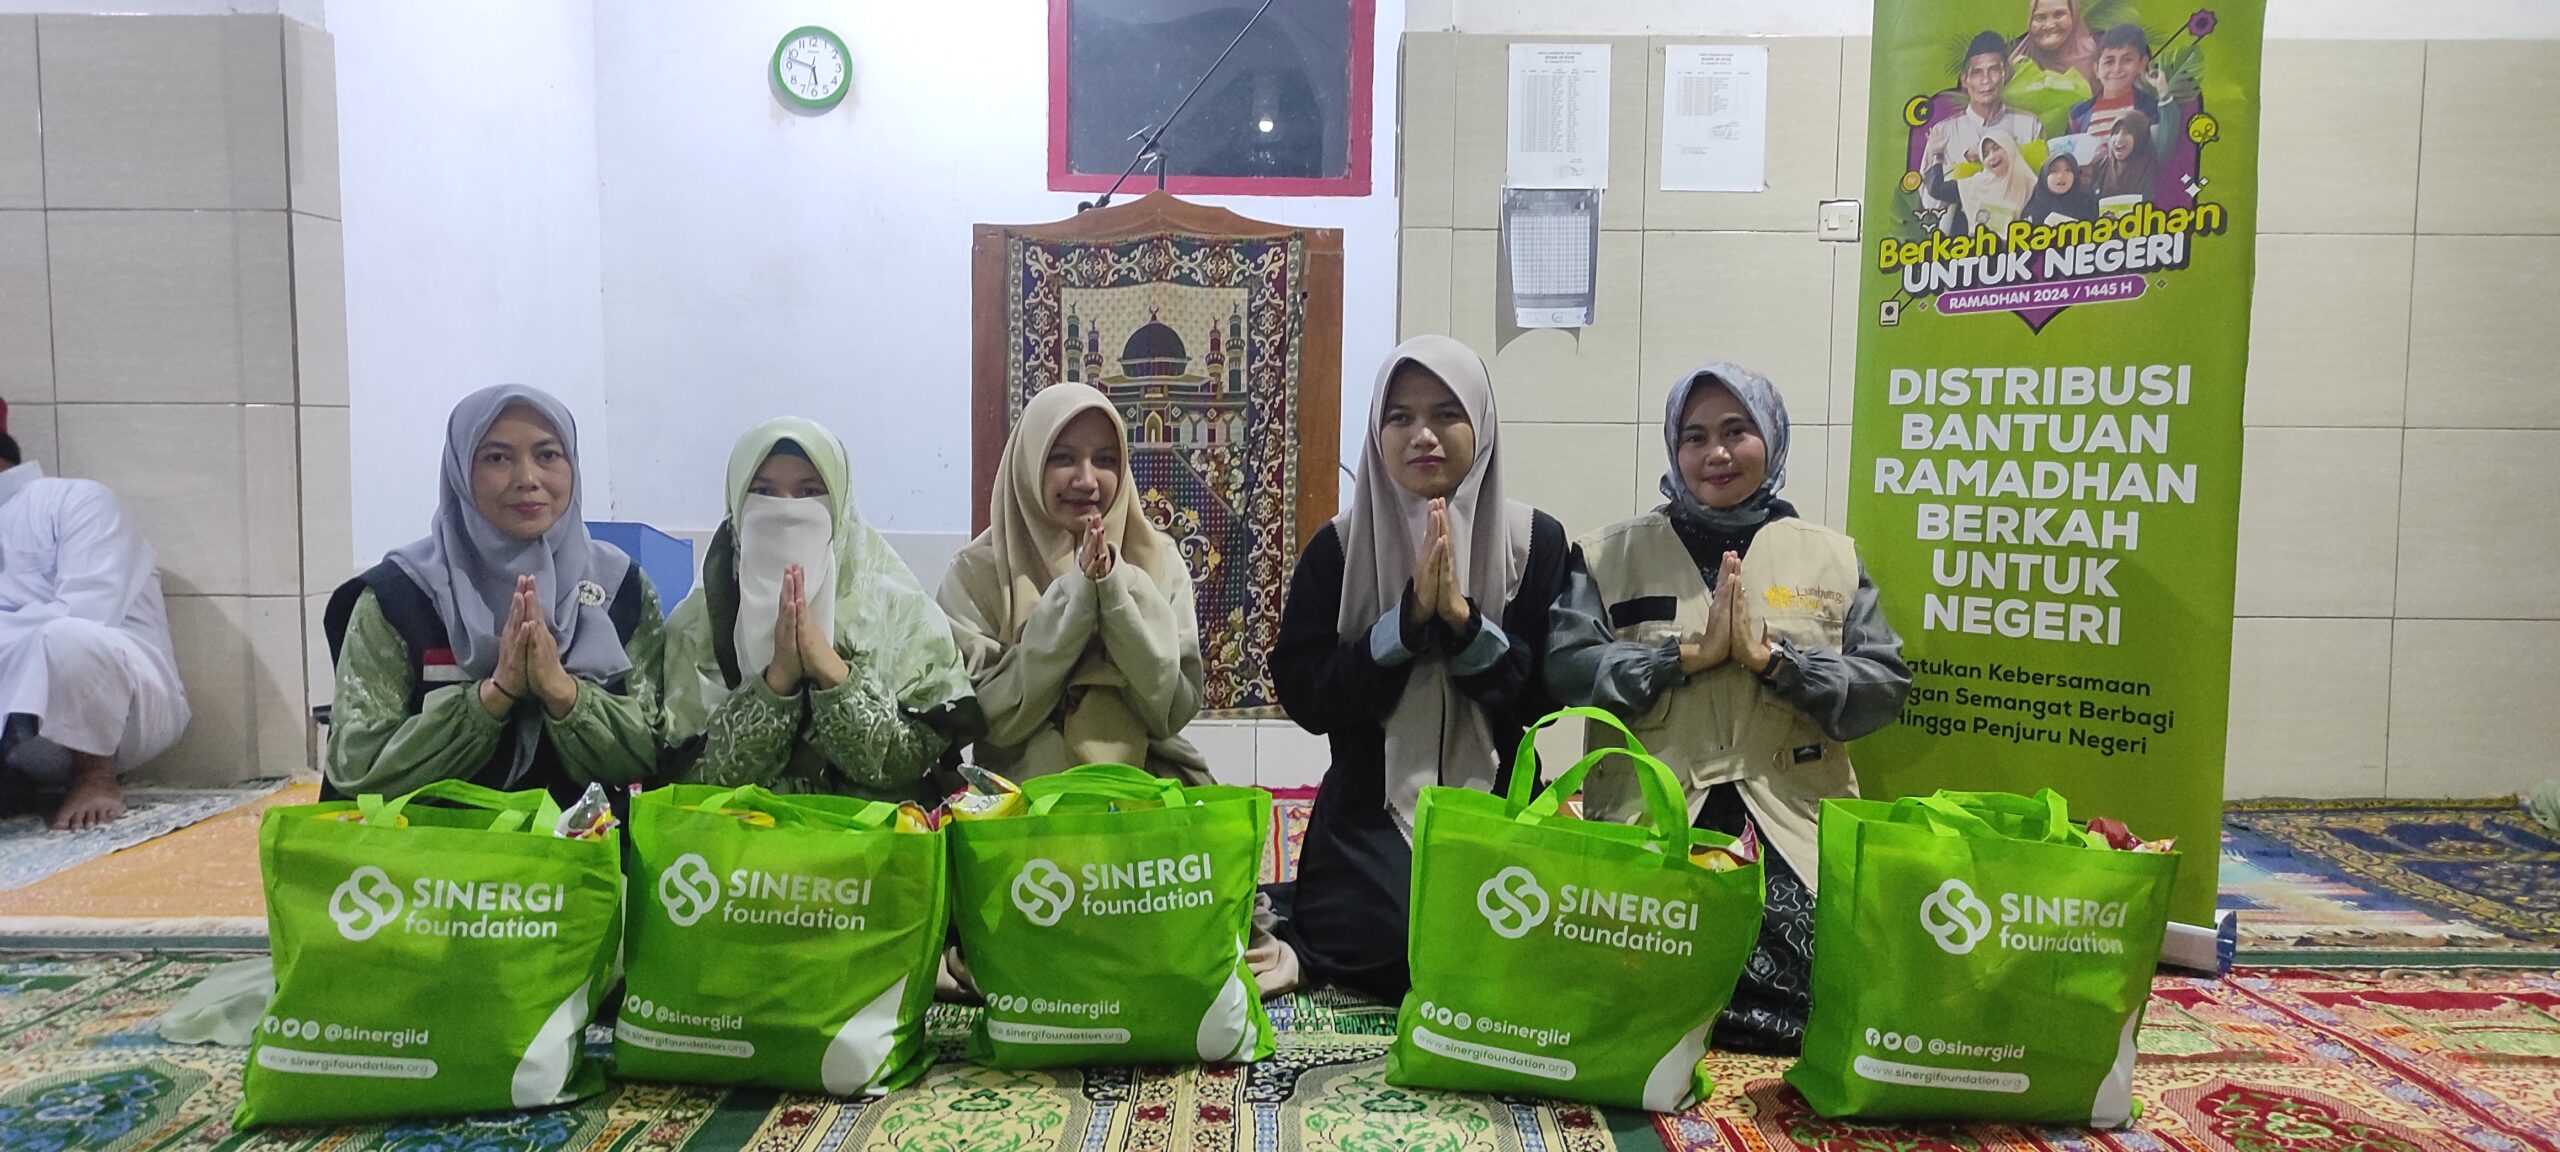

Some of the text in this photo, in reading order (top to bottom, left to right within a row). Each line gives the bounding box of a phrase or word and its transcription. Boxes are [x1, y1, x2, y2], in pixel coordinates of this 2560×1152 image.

[788, 48, 799, 59] 10
[798, 39, 805, 49] 11
[808, 36, 818, 47] 12
[831, 48, 838, 60] 2
[786, 61, 793, 72] 9
[790, 75, 797, 85] 8
[830, 75, 838, 87] 4
[834, 62, 842, 73] 3
[800, 84, 806, 95] 7
[811, 87, 818, 97] 6
[822, 84, 829, 95] 5
[1879, 201, 2221, 269] Berkah Ramadhan
[1902, 231, 2185, 293] UNTUK NEGERI
[1949, 281, 2133, 311] RAMADHAN 2024 / 1445 H
[1888, 365, 2192, 406] DISTRIBUSI
[1901, 413, 2170, 454] BANTUAN
[1874, 457, 2198, 504] RAMADHAN
[1916, 503, 2140, 551] BERKAH
[1932, 548, 2120, 598] UNTUK
[1923, 593, 2122, 646] NEGERI
[1906, 658, 2151, 697] atukan Kebersamaan
[1908, 686, 2175, 734] gan Semangat Berbagi
[1973, 716, 2061, 744] Penjuru
[2068, 728, 2147, 757] Negeri
[1081, 852, 1213, 892] SINERGI
[413, 877, 565, 913] SINERGI
[728, 869, 872, 906] SINERGI
[1081, 887, 1213, 917] foundation
[723, 900, 866, 931] foundation
[1558, 884, 1699, 931] SINERGI
[1999, 892, 2129, 929] SINERGI
[404, 910, 558, 938] foundation
[1553, 914, 1693, 957] foundation
[1999, 925, 2124, 955] foundation
[656, 1006, 744, 1032] @sinergiid
[1031, 997, 1121, 1020] @sinergiid
[324, 1023, 429, 1049] @sinergiid
[991, 1027, 1123, 1042] w.sinergifoundation.org
[1476, 1016, 1571, 1048] @sinergiid
[1928, 1038, 2026, 1063] @sinergiid
